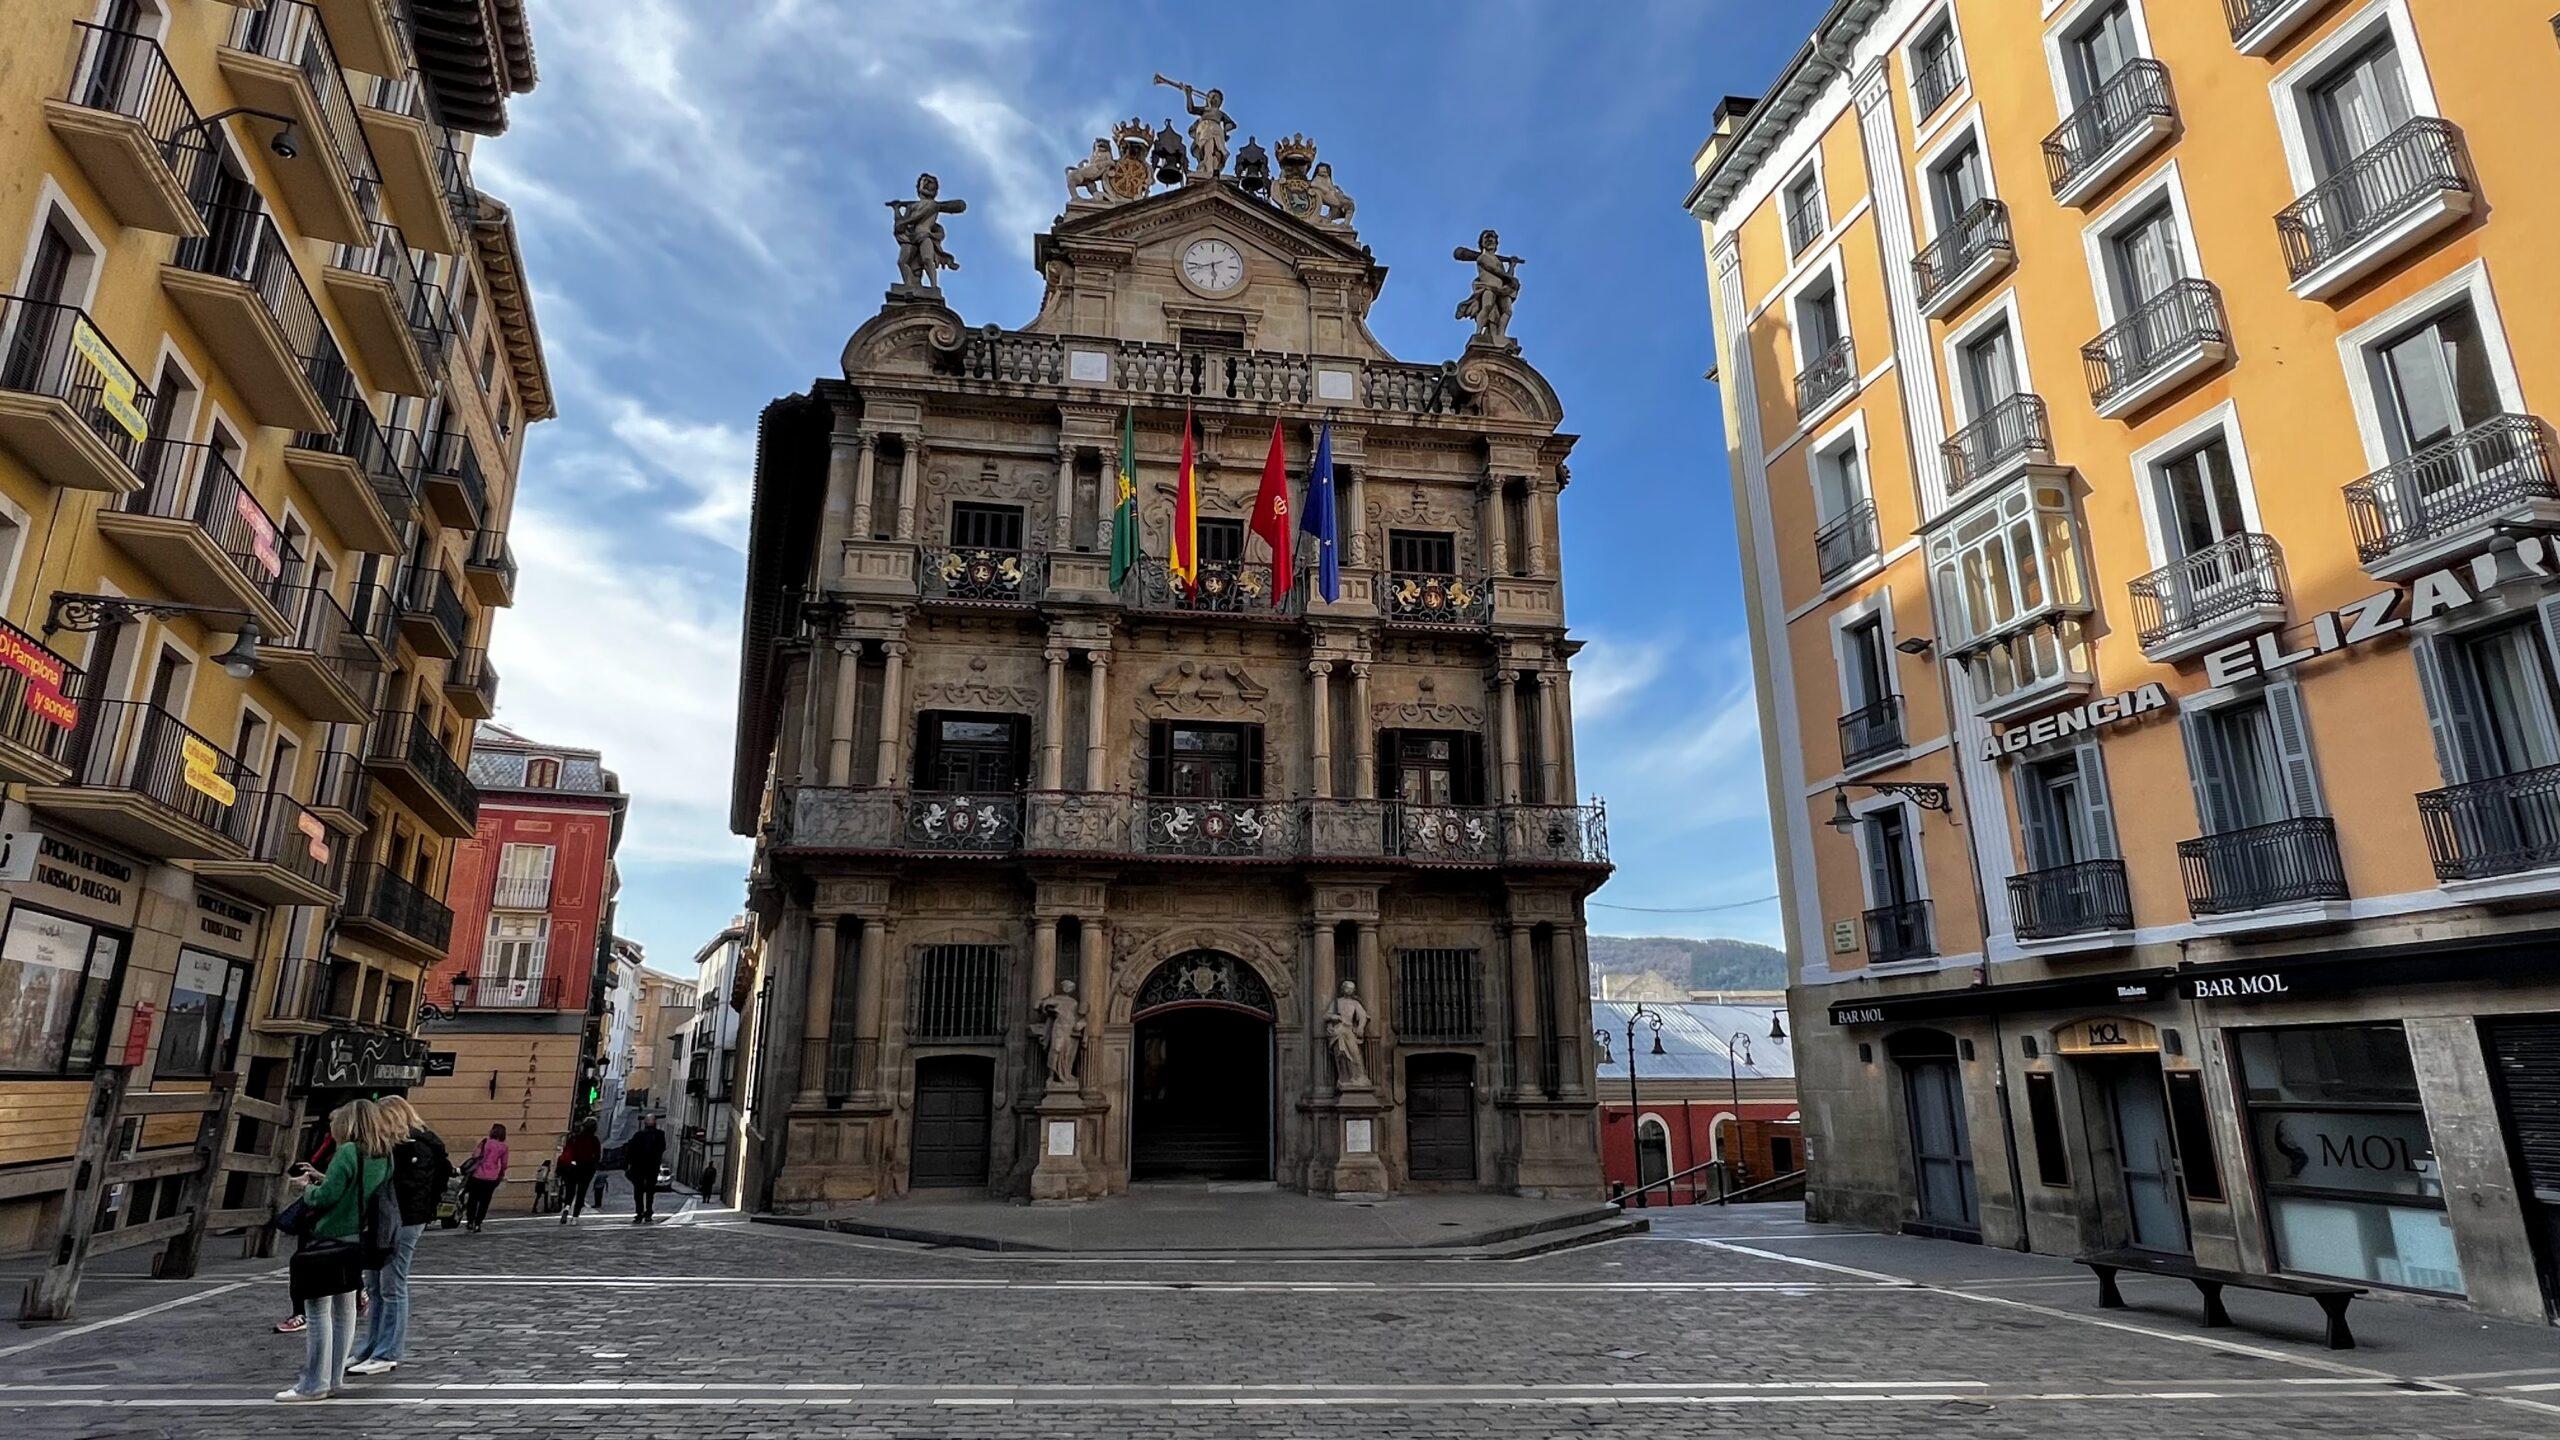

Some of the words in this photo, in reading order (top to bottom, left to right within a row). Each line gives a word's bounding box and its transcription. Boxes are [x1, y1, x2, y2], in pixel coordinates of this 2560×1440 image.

[10, 642, 59, 686] Pamplona
[1980, 682, 2167, 762] AGENCIA
[40, 836, 80, 866] OFICINA
[80, 851, 94, 871] DE
[92, 856, 131, 883] TURISMO
[37, 864, 80, 892] TURISMO
[80, 878, 121, 906] BULEGOA
[2195, 978, 2238, 998] BAR
[2239, 974, 2288, 995] MOL
[1839, 1010, 1860, 1024] BAR
[1860, 1008, 1884, 1022] MOL
[2088, 1023, 2127, 1044] MOL
[519, 1042, 539, 1132] FARMACIA
[2316, 1133, 2428, 1174] MOL
